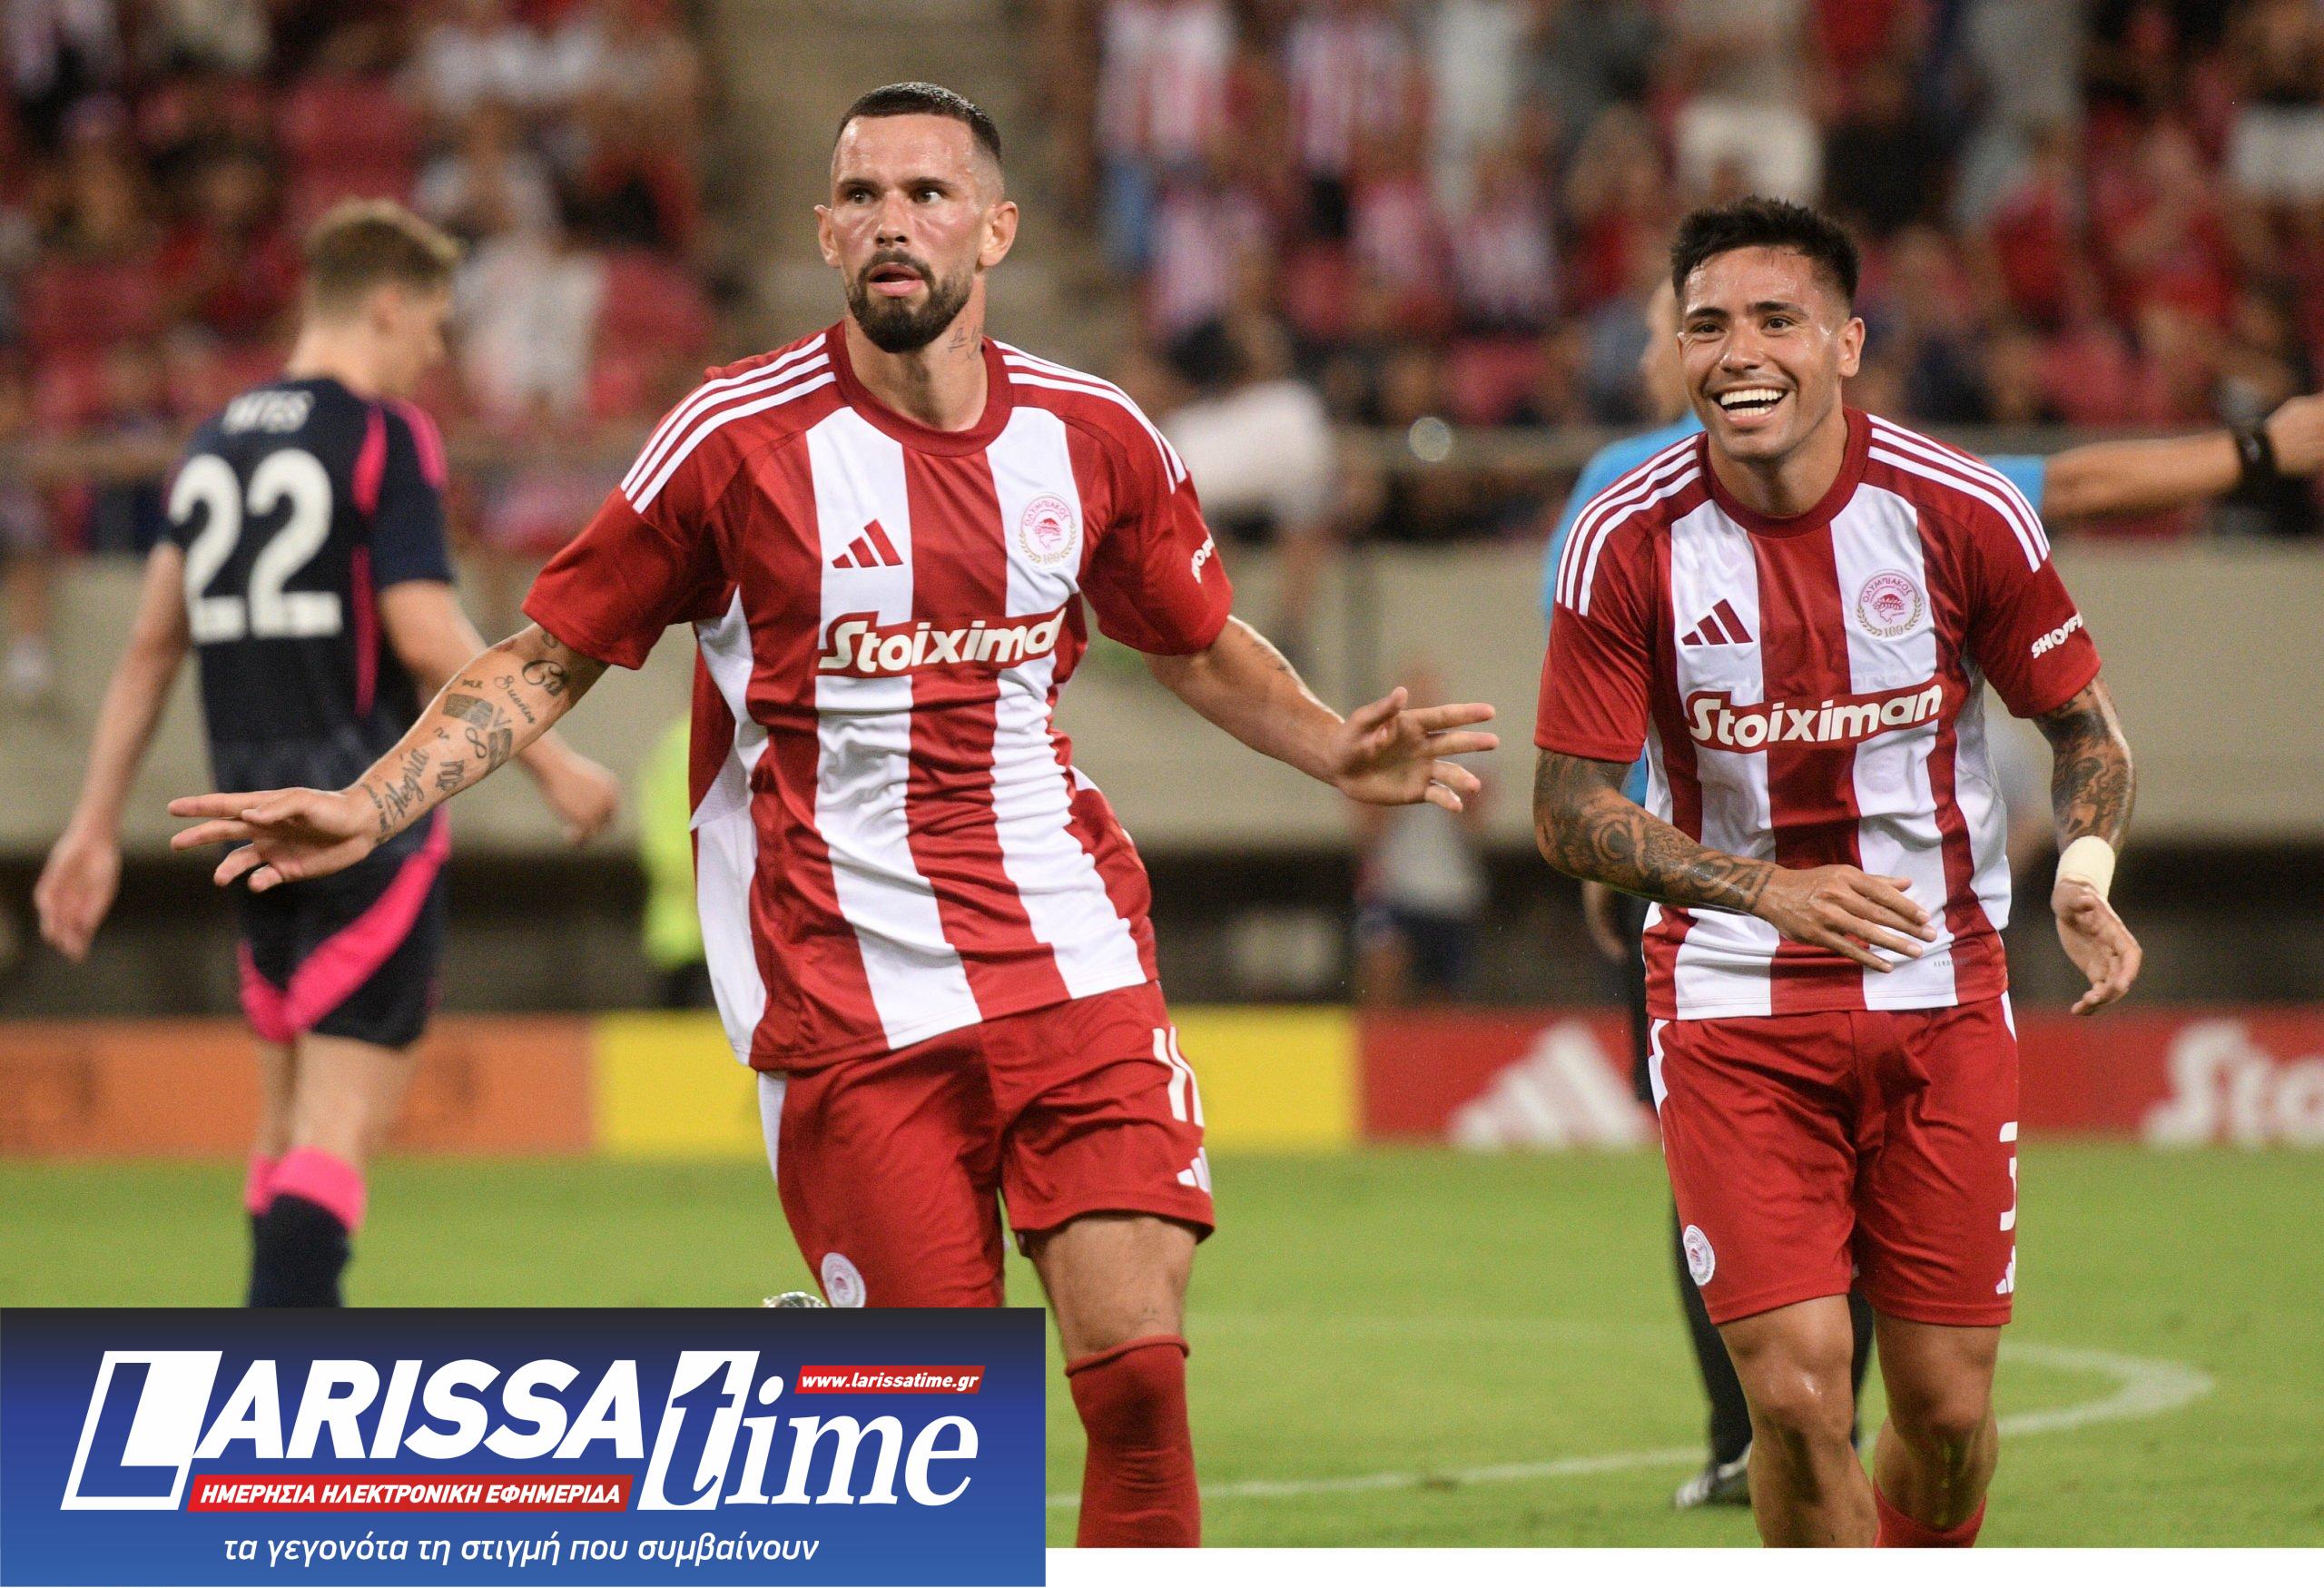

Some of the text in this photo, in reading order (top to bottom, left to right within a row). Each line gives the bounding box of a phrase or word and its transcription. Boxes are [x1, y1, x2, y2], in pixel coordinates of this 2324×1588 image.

[168, 448, 342, 643] 22
[1689, 684, 1943, 747] Stoiximan
[1152, 1025, 1206, 1129] 11
